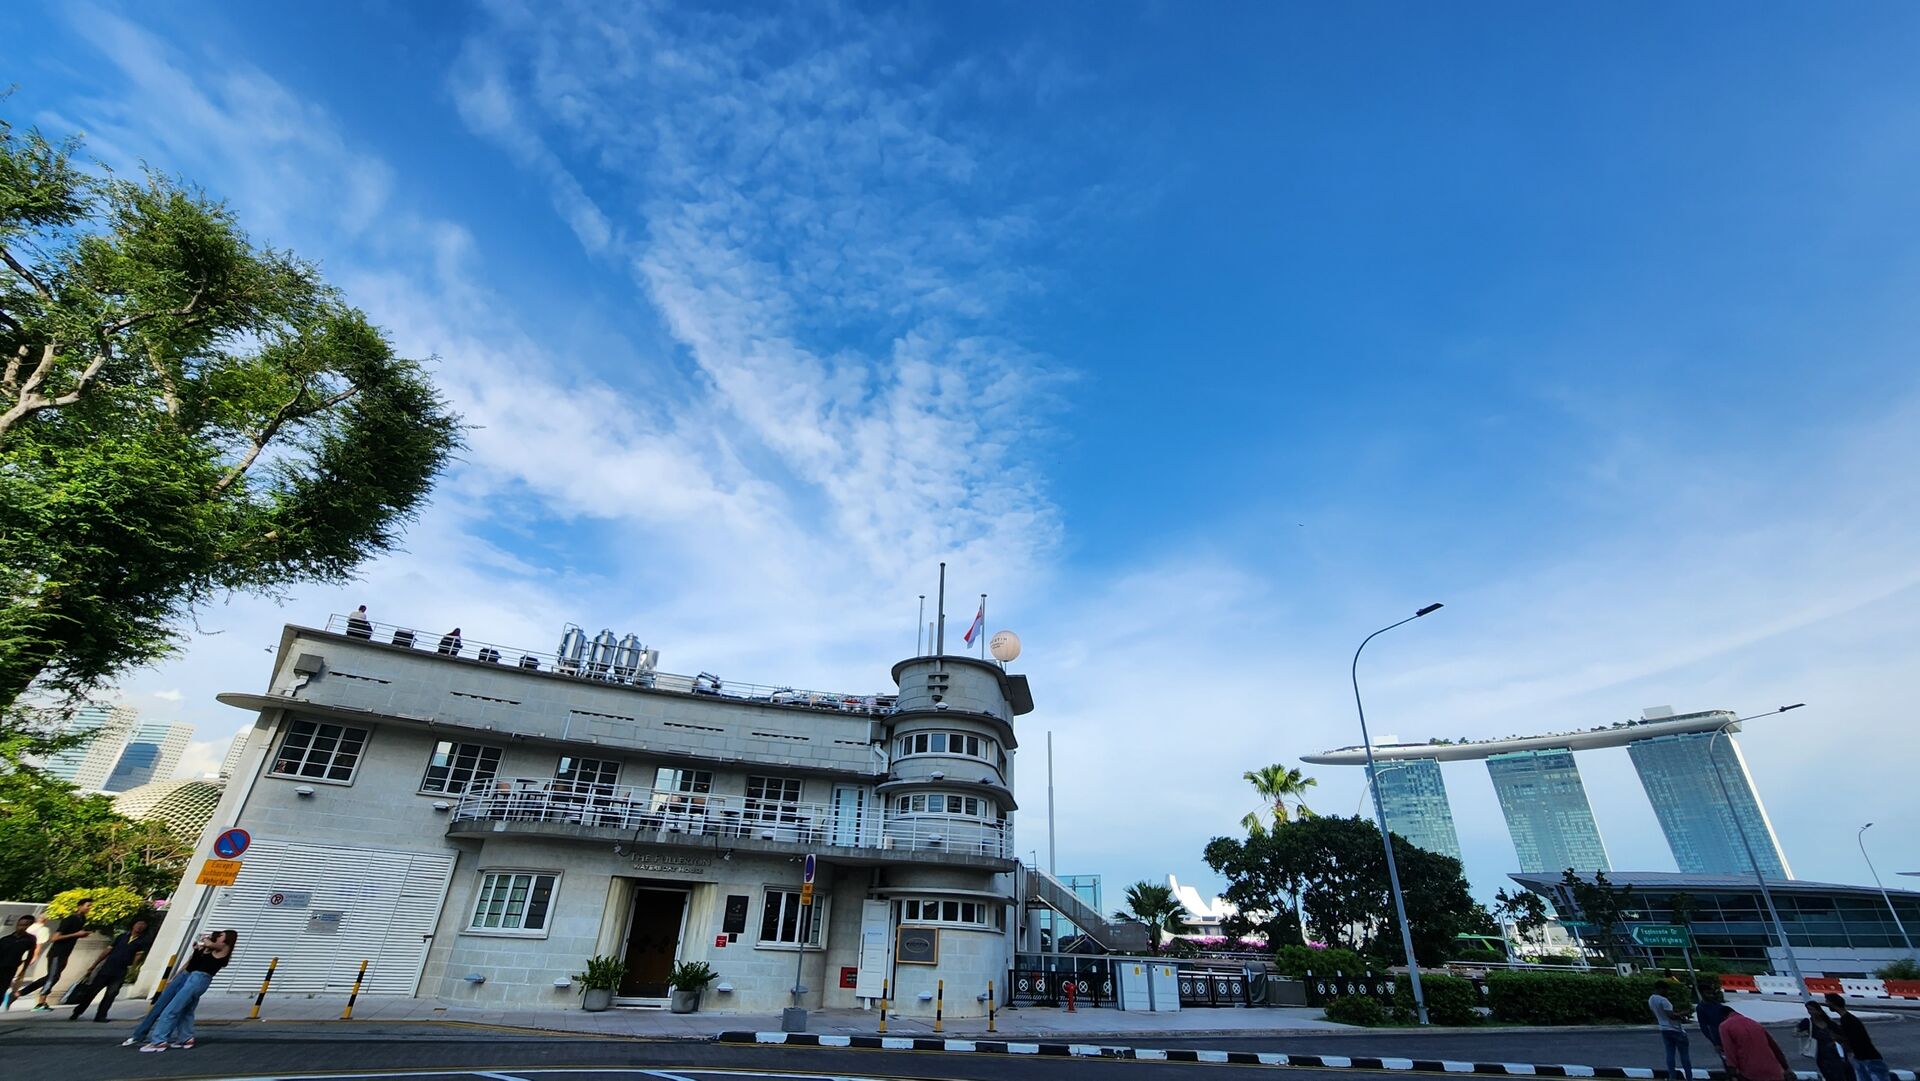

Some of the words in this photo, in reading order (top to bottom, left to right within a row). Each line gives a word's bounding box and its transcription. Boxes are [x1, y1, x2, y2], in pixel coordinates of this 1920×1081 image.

[631, 852, 651, 862] THE
[654, 855, 712, 867] FULLERTON
[633, 863, 677, 873] WATERBOAT
[678, 866, 704, 875] HOUSE
